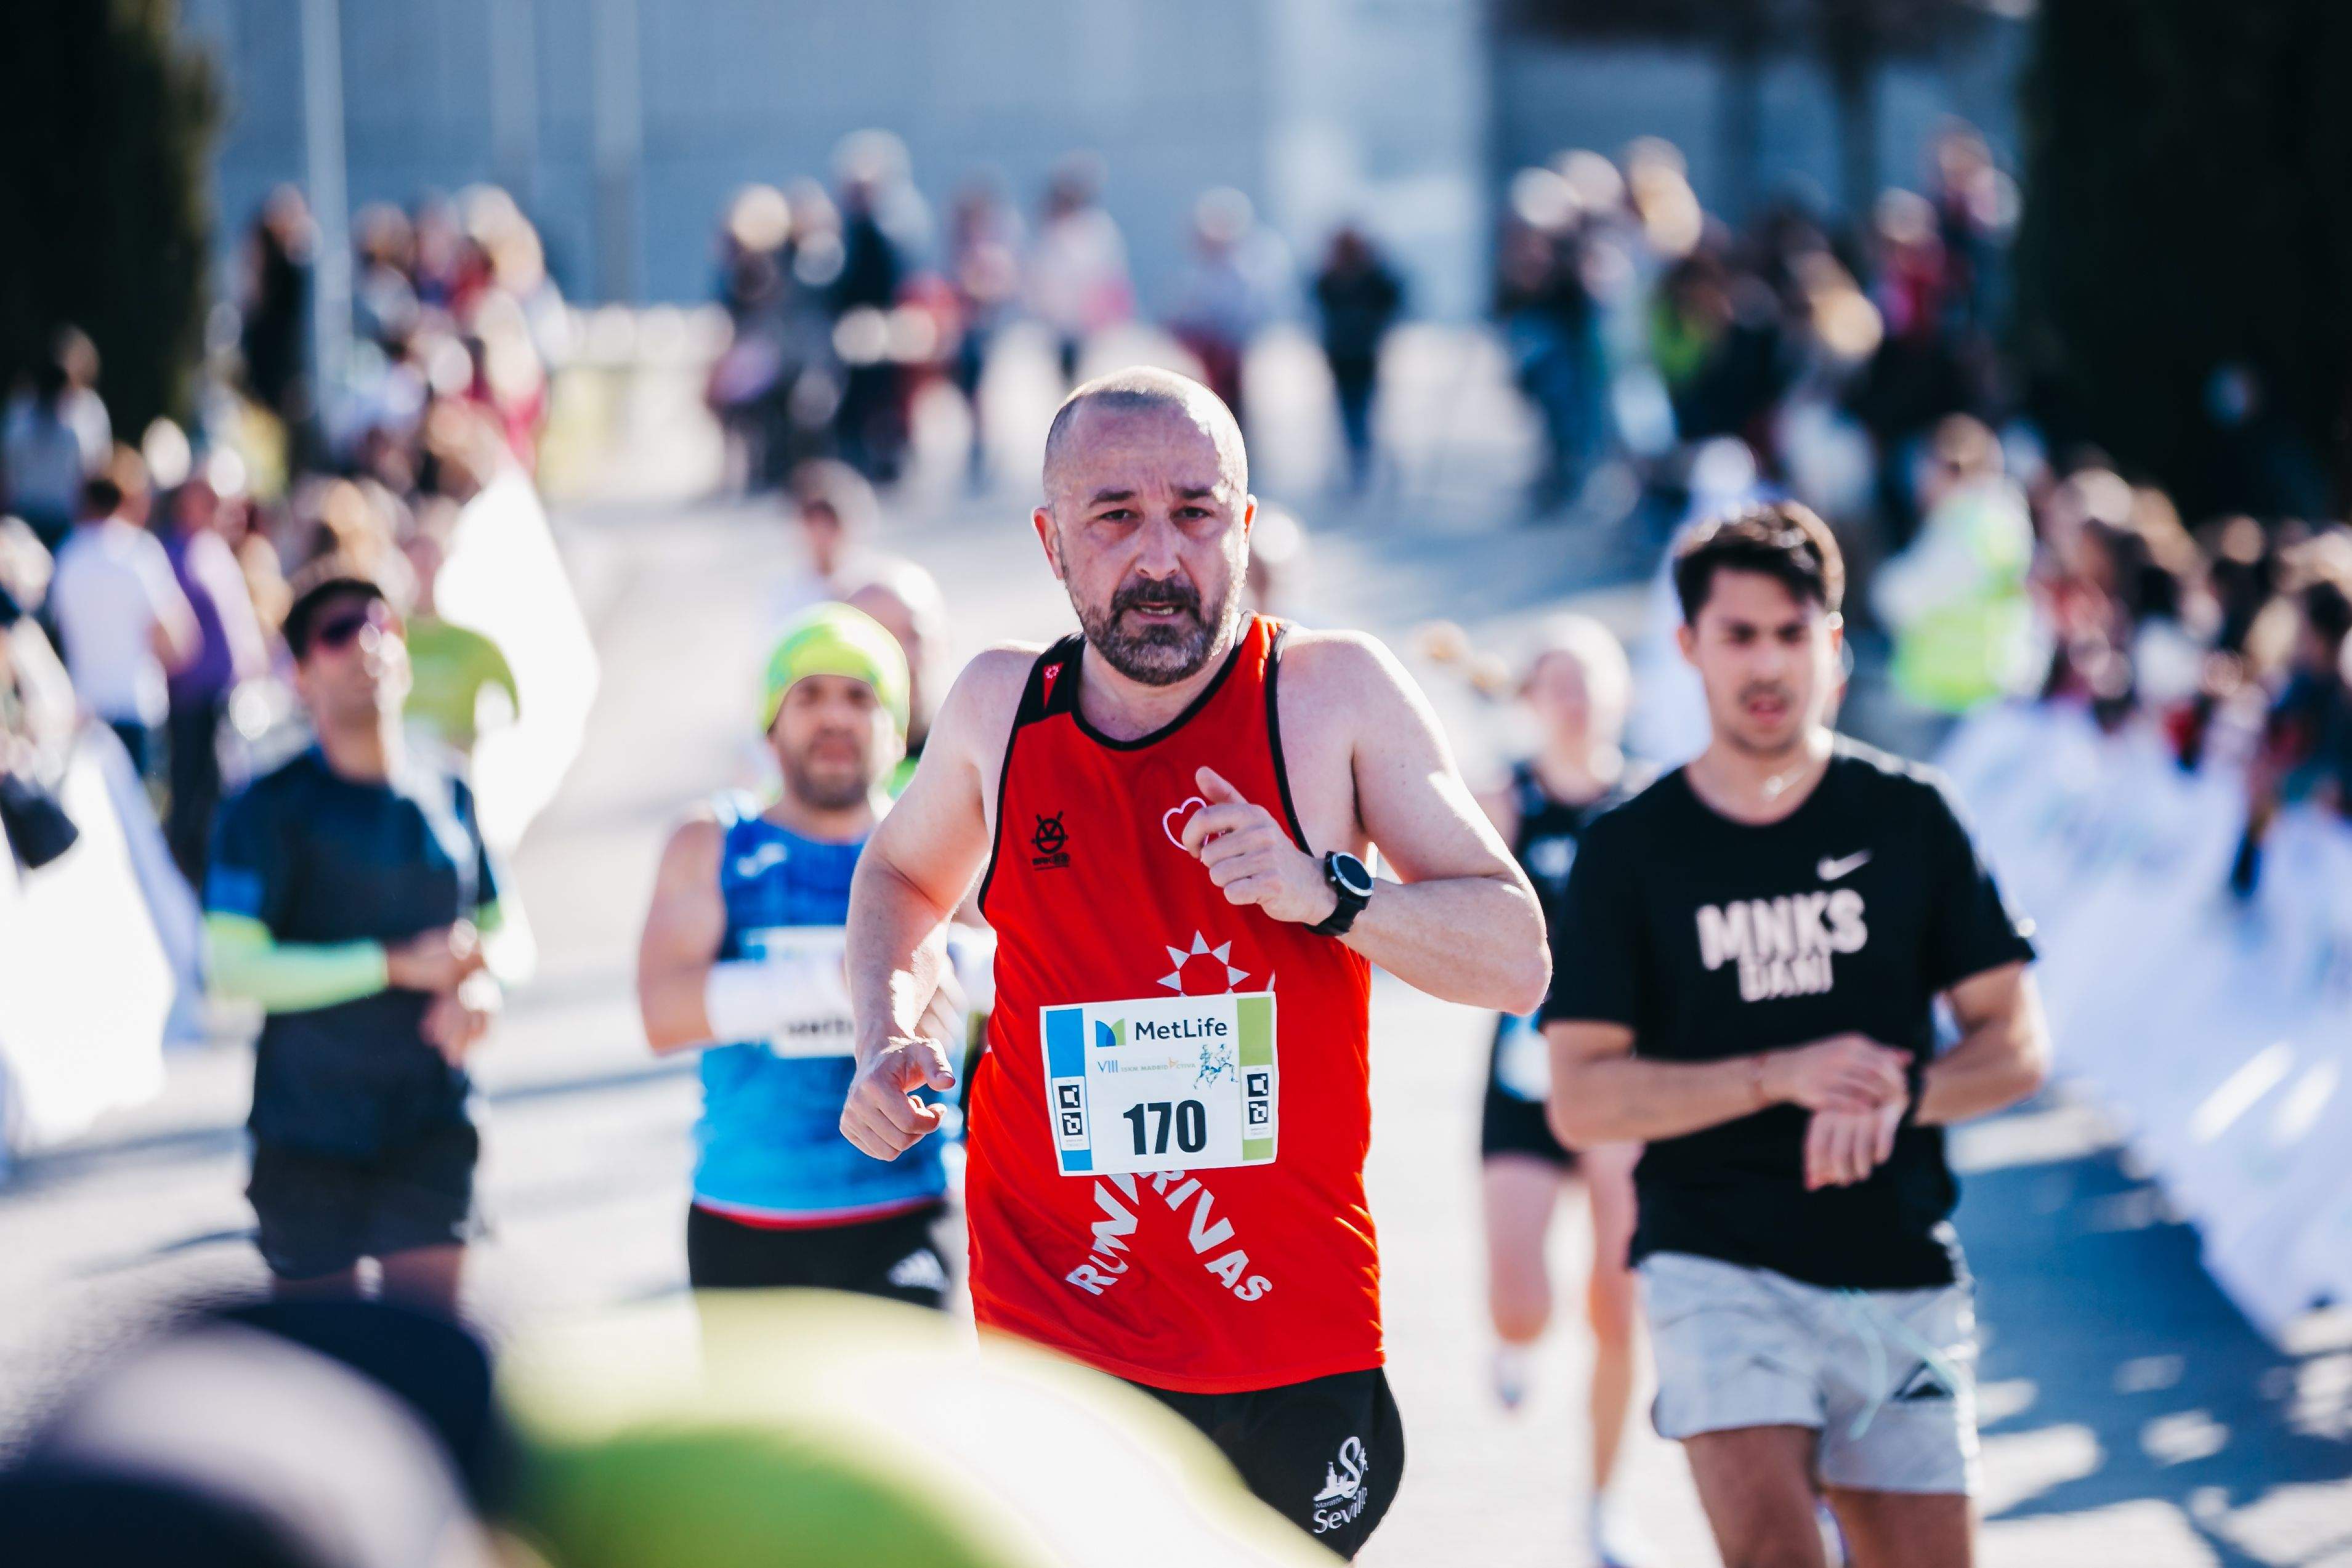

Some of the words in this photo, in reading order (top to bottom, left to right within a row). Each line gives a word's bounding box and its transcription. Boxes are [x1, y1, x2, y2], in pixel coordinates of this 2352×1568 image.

[1696, 889, 1868, 970] MNKS
[1135, 1017, 1227, 1040] MetLife
[1097, 1059, 1118, 1073] VIII
[1123, 1099, 1208, 1156] 170
